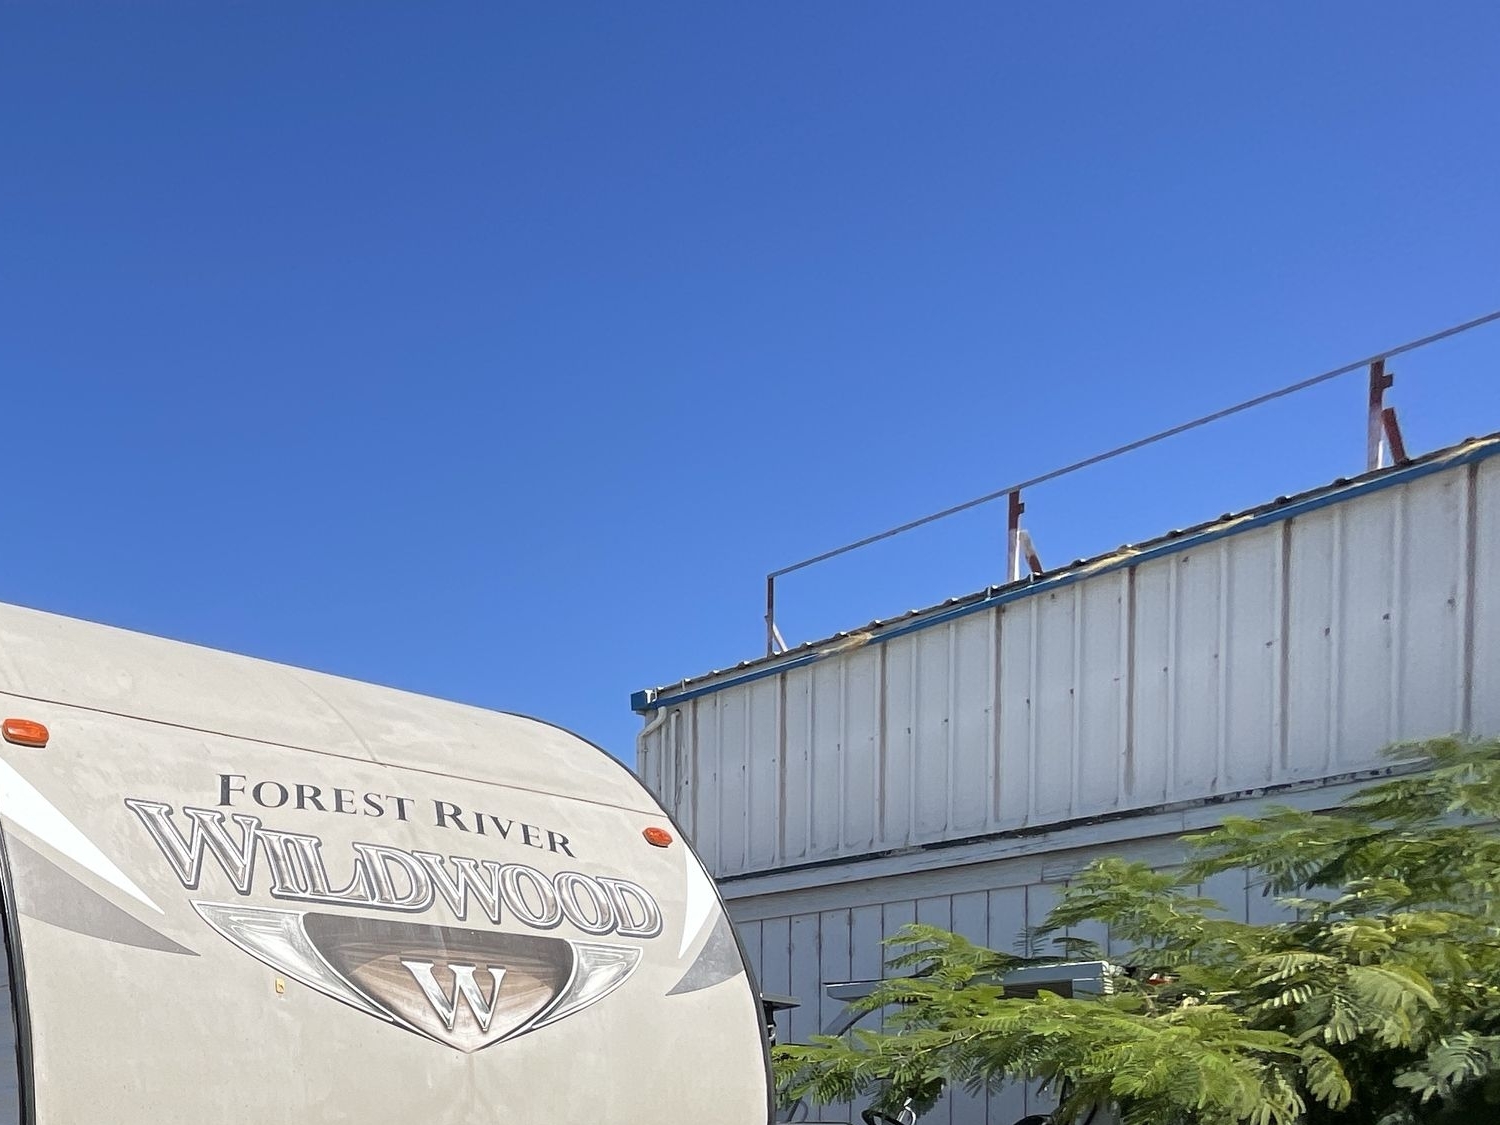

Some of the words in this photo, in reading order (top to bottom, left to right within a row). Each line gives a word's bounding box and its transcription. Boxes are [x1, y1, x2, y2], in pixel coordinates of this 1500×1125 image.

[217, 773, 415, 823] FOREST
[435, 800, 577, 858] RIVER
[124, 797, 663, 938] WILDWOOD
[402, 960, 507, 1032] W
